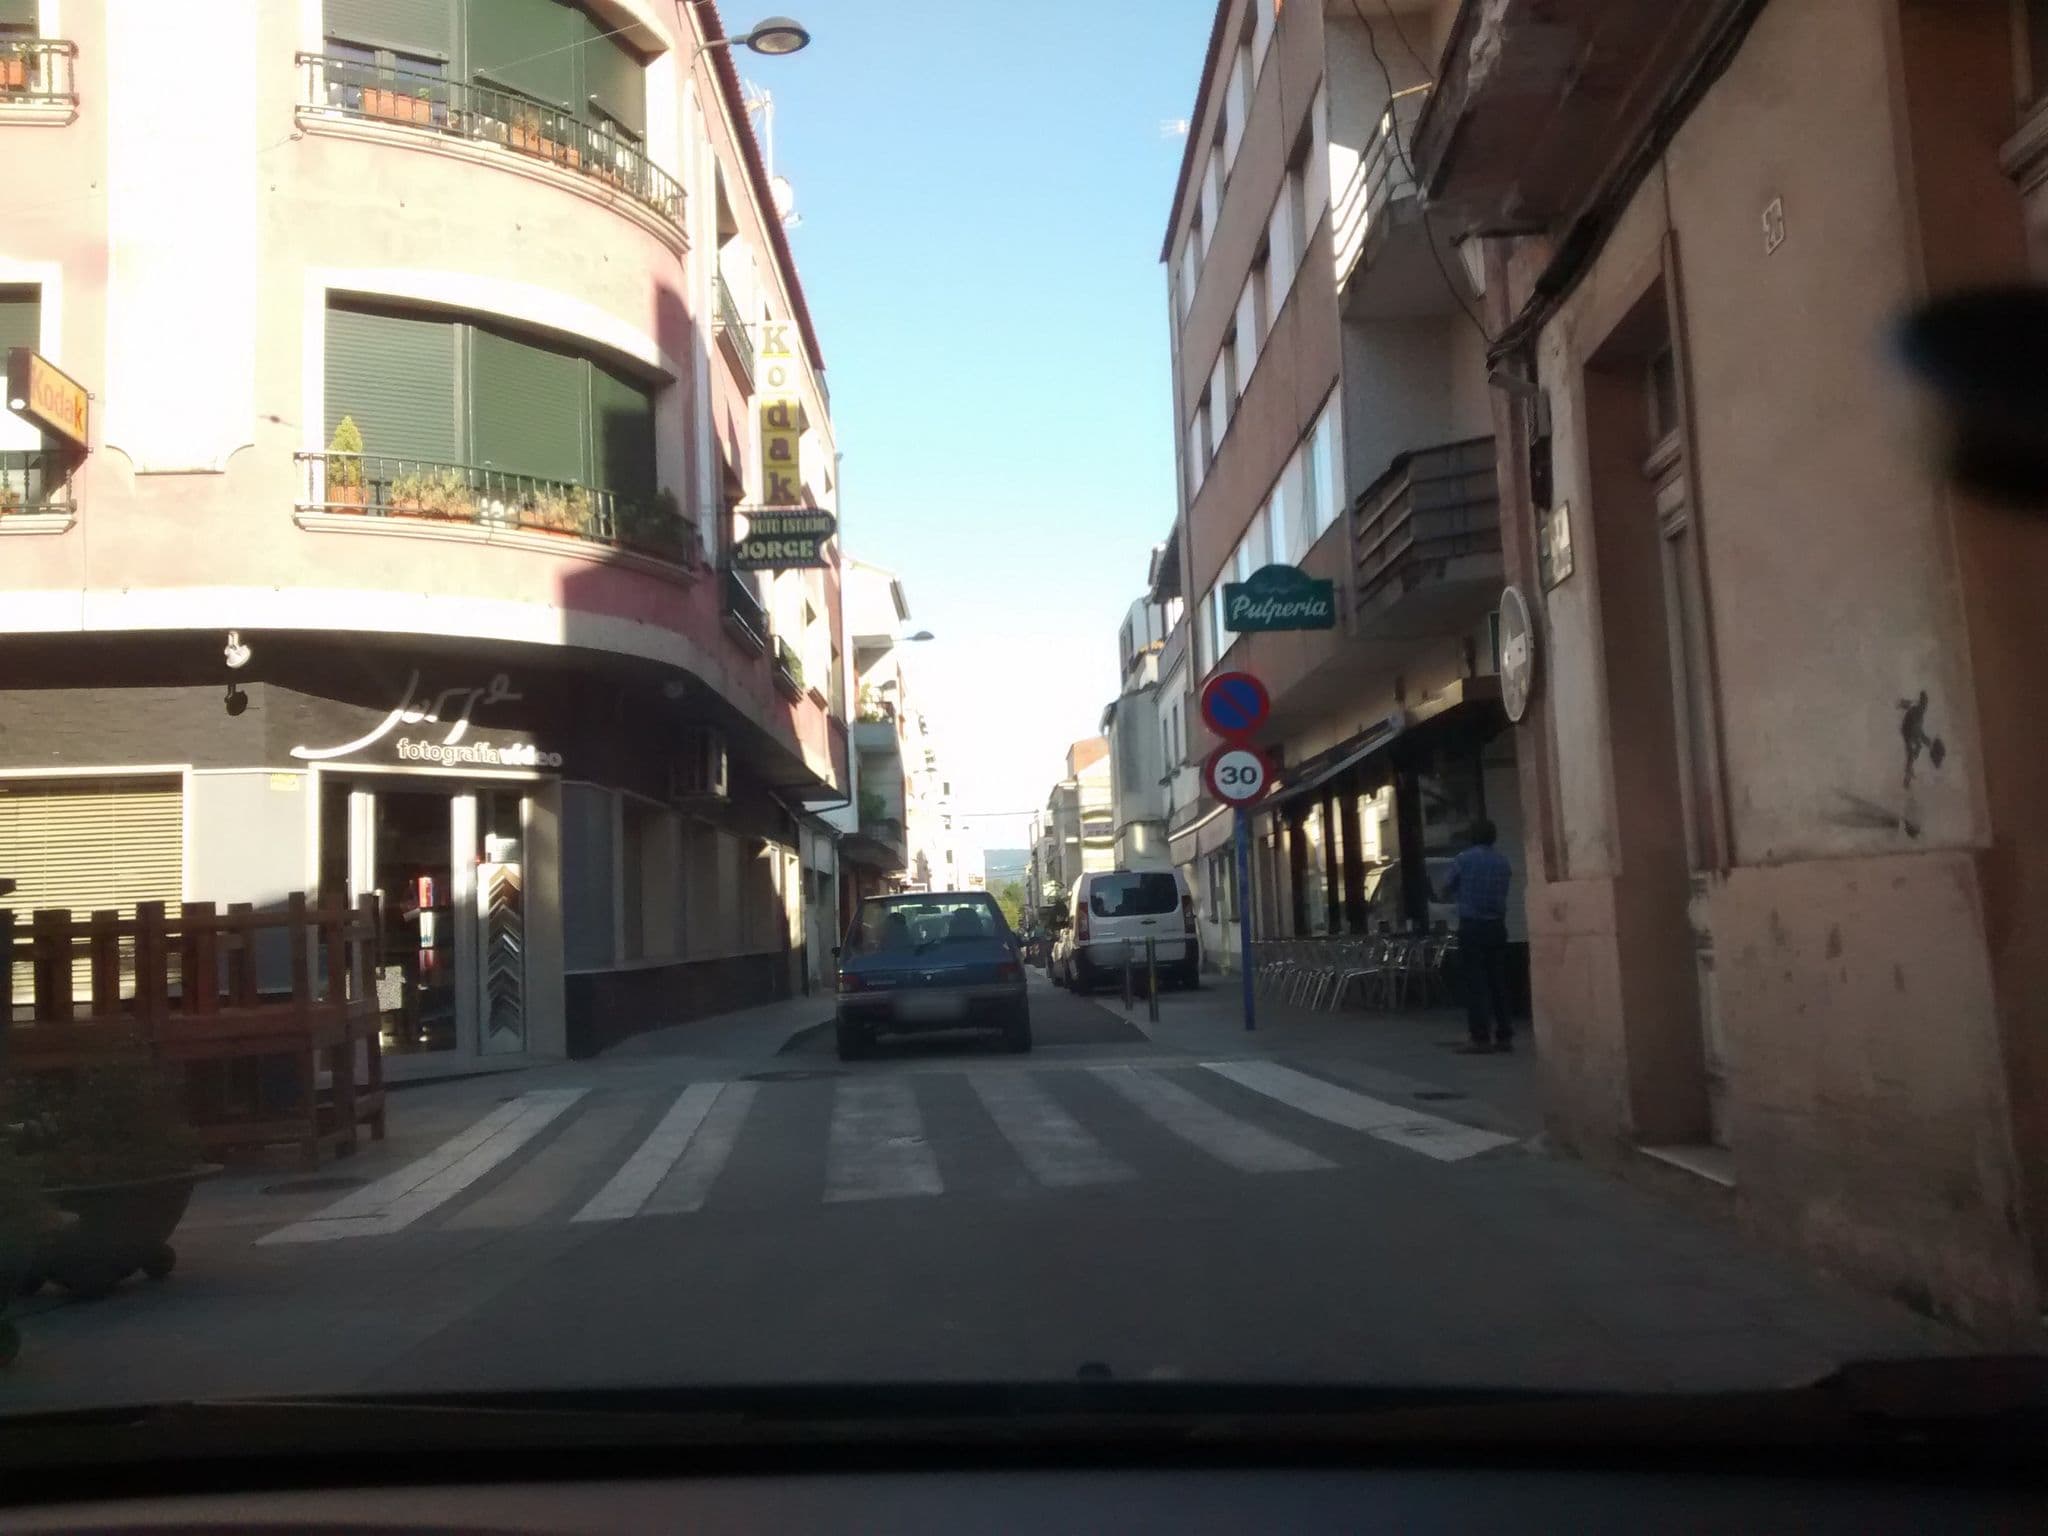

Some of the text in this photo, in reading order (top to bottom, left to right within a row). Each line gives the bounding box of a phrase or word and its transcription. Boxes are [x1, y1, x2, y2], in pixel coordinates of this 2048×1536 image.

[31, 363, 84, 433] Kodak
[763, 325, 794, 501] Kodak
[737, 541, 814, 559] JORGE
[1221, 766, 1257, 785] 30
